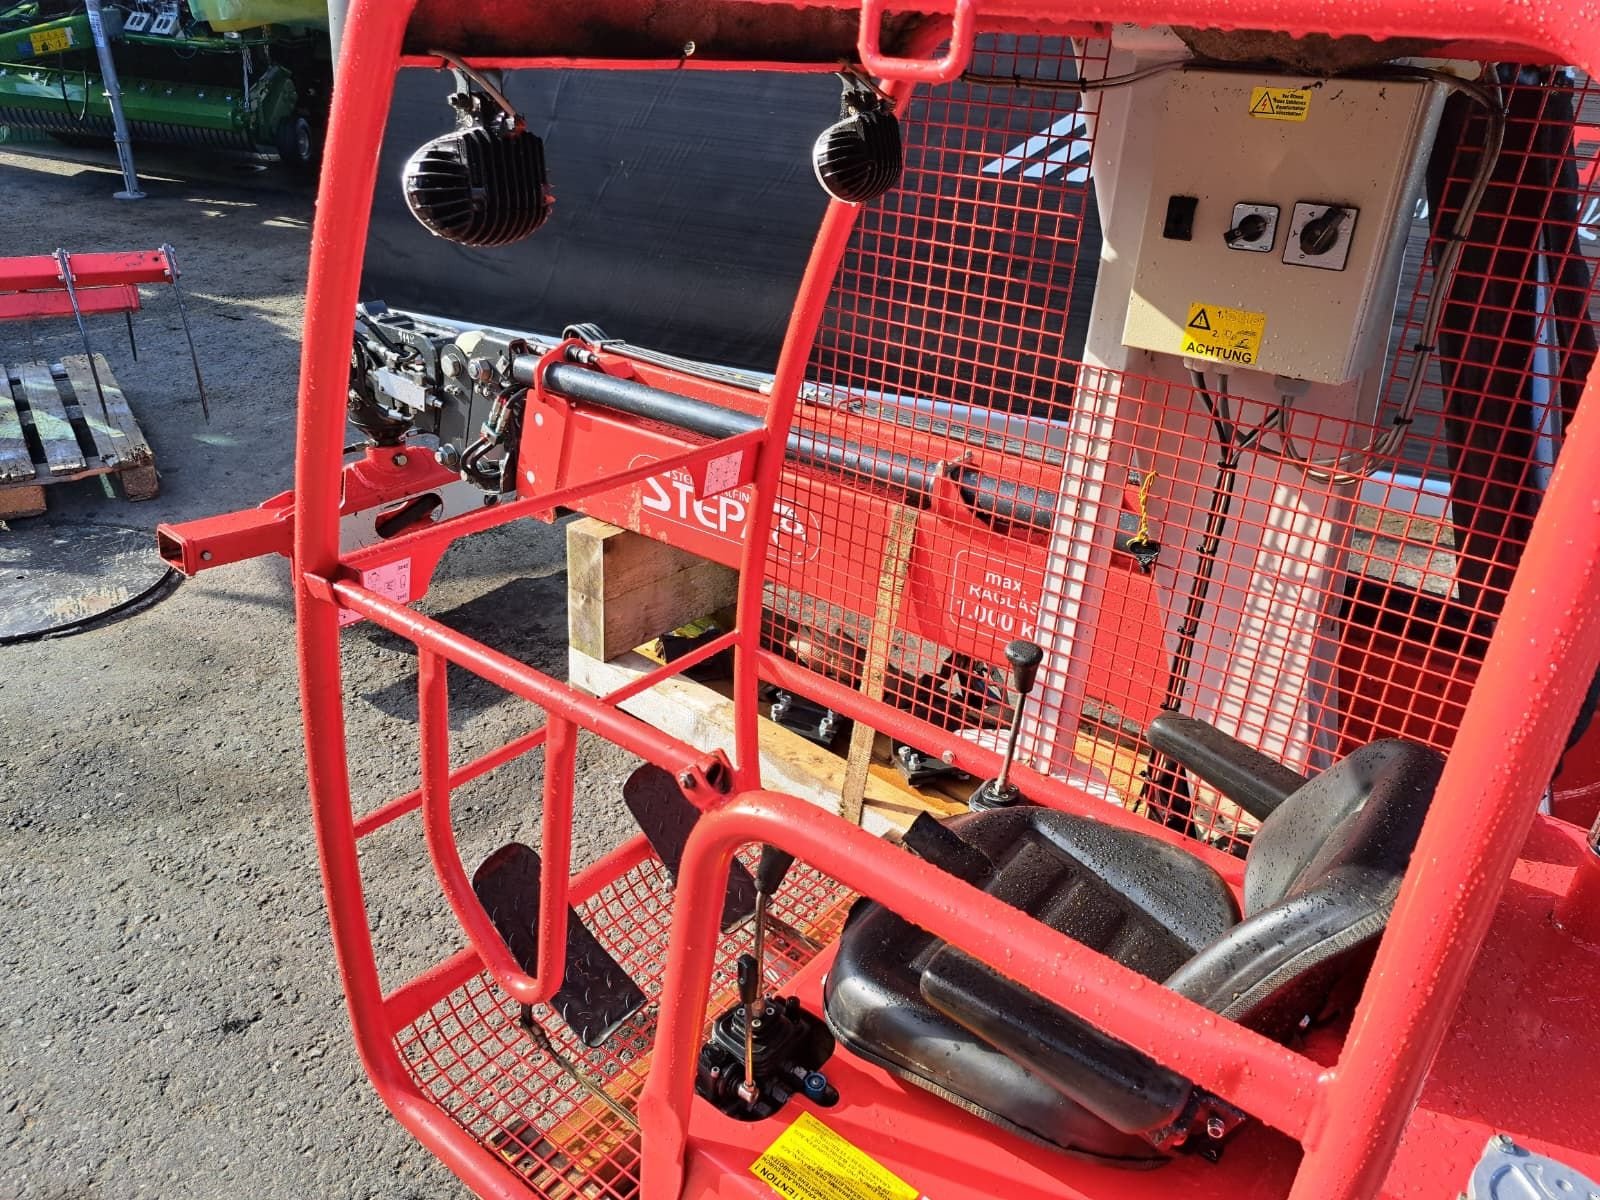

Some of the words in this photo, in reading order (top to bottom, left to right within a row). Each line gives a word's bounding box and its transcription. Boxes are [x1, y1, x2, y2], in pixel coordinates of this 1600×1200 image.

[1186, 341, 1252, 364] ACHTUNG
[641, 468, 748, 540] STEP
[985, 571, 1028, 595] max.
[956, 599, 1014, 632] 1.000
[758, 1166, 805, 1200] TENTION
